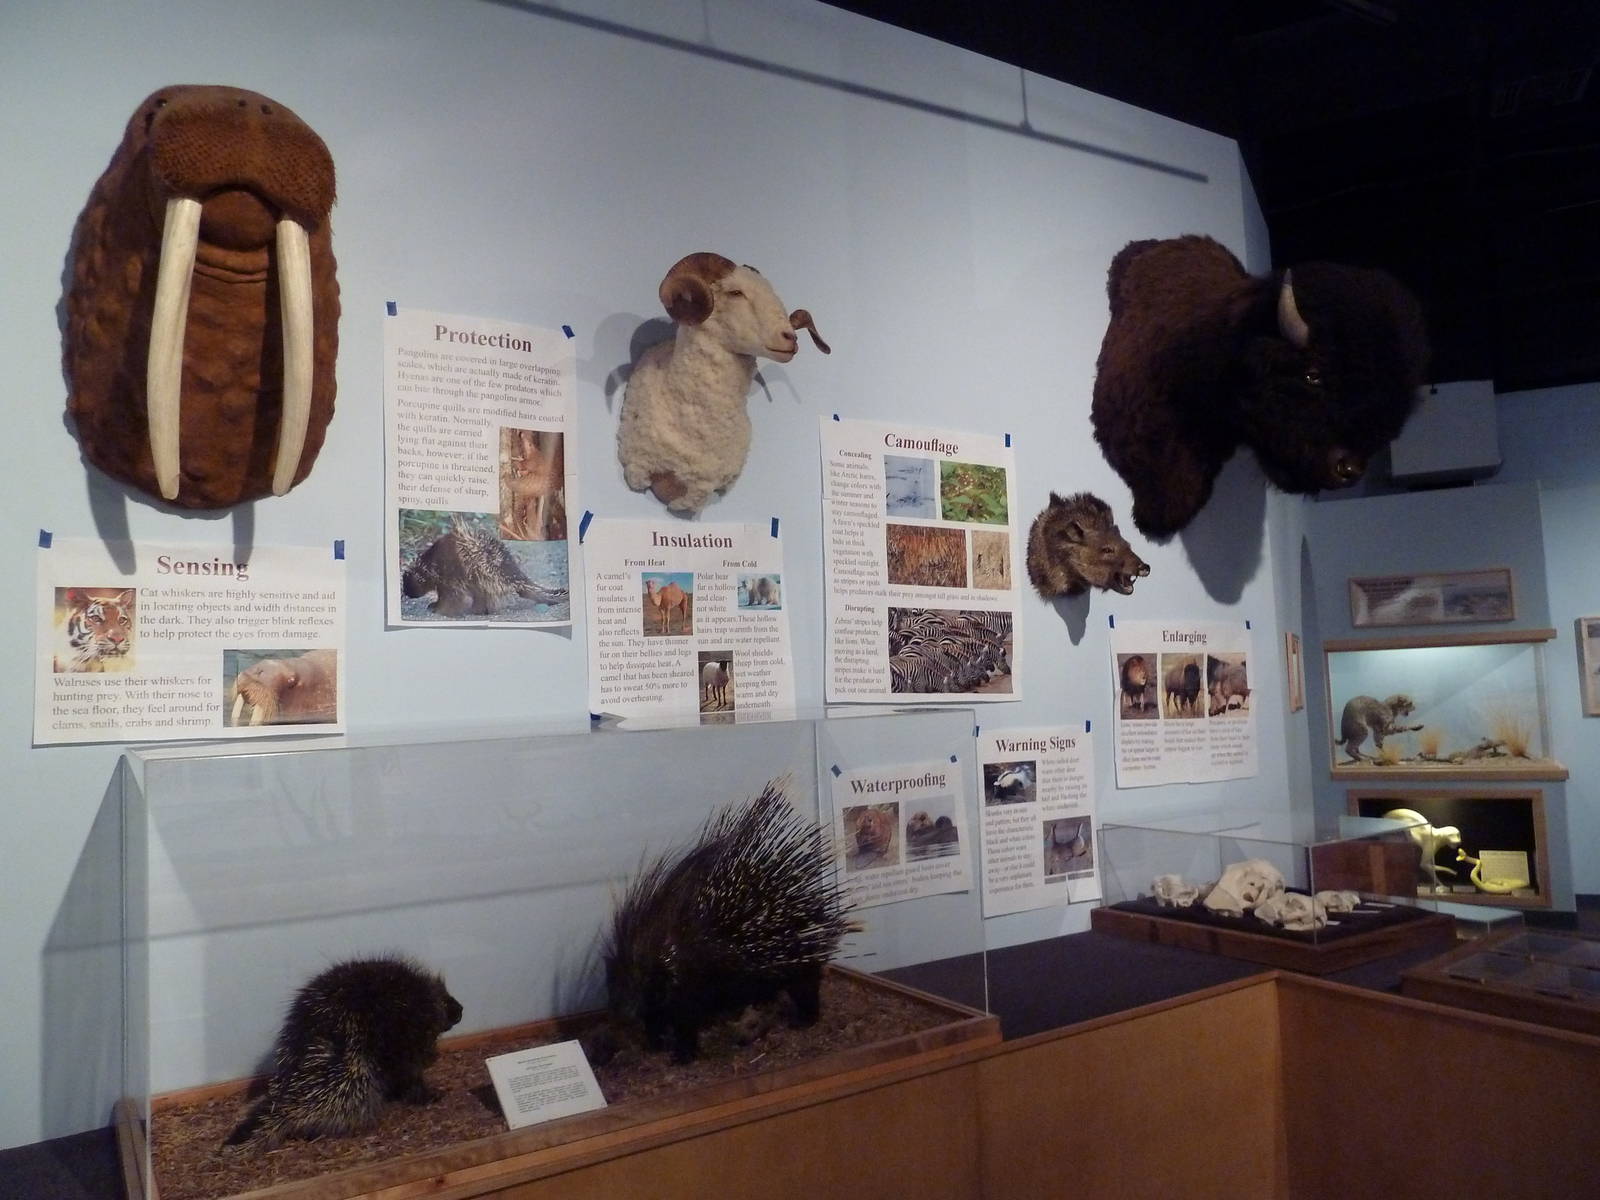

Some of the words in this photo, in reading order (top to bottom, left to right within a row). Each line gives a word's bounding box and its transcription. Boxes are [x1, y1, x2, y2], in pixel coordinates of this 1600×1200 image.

[434, 325, 532, 352] Protection
[454, 366, 467, 374] are
[469, 366, 499, 379] actually
[502, 371, 522, 381] made
[524, 373, 533, 382] of
[499, 359, 518, 371] large
[519, 363, 561, 377] overlapping
[432, 385, 464, 399] through
[480, 390, 517, 403] pangolins
[488, 379, 502, 389] few
[504, 383, 538, 395] predators
[539, 387, 562, 398] which
[398, 399, 440, 412] Porcupine
[442, 402, 466, 414] quills
[483, 407, 517, 418] modified
[518, 410, 537, 421] hairs
[397, 423, 411, 432] the
[397, 434, 419, 446] lying
[884, 433, 960, 456] Camouflage
[839, 449, 872, 460] Concealing
[398, 459, 440, 471] porcupine
[442, 461, 449, 470] is
[451, 463, 495, 474] threatened,
[398, 470, 417, 481] they
[435, 473, 465, 485] quickly
[398, 482, 417, 492] their
[419, 484, 451, 494] defense
[454, 485, 463, 495] of
[465, 487, 489, 498] sharp,
[651, 531, 733, 548] Insulation
[156, 555, 250, 581] Sensing
[624, 558, 646, 567] From
[647, 559, 666, 567] Heat
[722, 560, 740, 568] From
[740, 560, 758, 568] Cold
[596, 583, 608, 592] fur
[608, 584, 624, 592] coat
[140, 588, 159, 598] Cat
[161, 588, 206, 599] whiskers
[208, 590, 224, 600] are
[226, 589, 257, 602] highly
[259, 590, 300, 600] sensitive
[302, 590, 320, 600] and
[321, 590, 336, 601] aid
[140, 602, 150, 612] in
[152, 601, 194, 614] locating
[196, 602, 231, 615] objects
[233, 603, 252, 612] and
[254, 602, 281, 613] width
[283, 603, 326, 613] distances
[327, 604, 337, 613] in
[597, 606, 615, 614] from
[845, 604, 875, 614] Disrupting
[140, 615, 156, 625] the
[158, 615, 185, 625] dark.
[187, 615, 213, 629] They
[215, 616, 236, 626] also
[237, 615, 269, 629] trigger
[271, 615, 296, 626] blink
[298, 615, 335, 626] reflexes
[597, 617, 613, 625] heat
[613, 617, 627, 625] and
[140, 629, 150, 639] to
[152, 629, 176, 642] help
[177, 629, 212, 642] protect
[214, 629, 231, 639] the
[232, 631, 255, 642] eyes
[256, 629, 284, 639] from
[285, 629, 320, 641] damage.
[598, 628, 613, 637] also
[614, 628, 640, 637] reflects
[1162, 630, 1208, 644] Enlarging
[598, 639, 611, 648] the
[627, 639, 645, 650] They
[646, 638, 663, 647] have
[600, 651, 610, 660] fur
[639, 650, 663, 659] bellies
[664, 649, 677, 658] and
[600, 663, 608, 671] to
[608, 661, 625, 672] help
[53, 677, 101, 687] Walruses
[104, 679, 122, 687] use
[124, 676, 148, 687] their
[150, 676, 196, 686] whiskers
[197, 675, 212, 686] for
[600, 673, 622, 682] camel
[623, 672, 637, 681] that
[638, 672, 651, 680] has
[651, 671, 668, 680] been
[669, 669, 694, 678] sheared
[600, 684, 614, 694] has
[614, 684, 622, 693] to
[662, 681, 680, 690] more
[680, 681, 688, 689] to
[53, 692, 94, 704] hunting
[125, 690, 150, 700] With
[152, 689, 176, 700] their
[177, 690, 201, 699] nose
[202, 689, 214, 699] to
[600, 695, 621, 704] avoid
[52, 705, 69, 716] the
[71, 707, 90, 716] sea
[122, 704, 144, 717] they
[147, 703, 166, 713] feel
[168, 702, 203, 713] around
[206, 701, 221, 712] for
[125, 717, 153, 728] crabs
[154, 716, 174, 727] and
[995, 738, 1047, 753] Warning
[1049, 736, 1077, 752] Signs
[850, 772, 946, 794] Waterproofing
